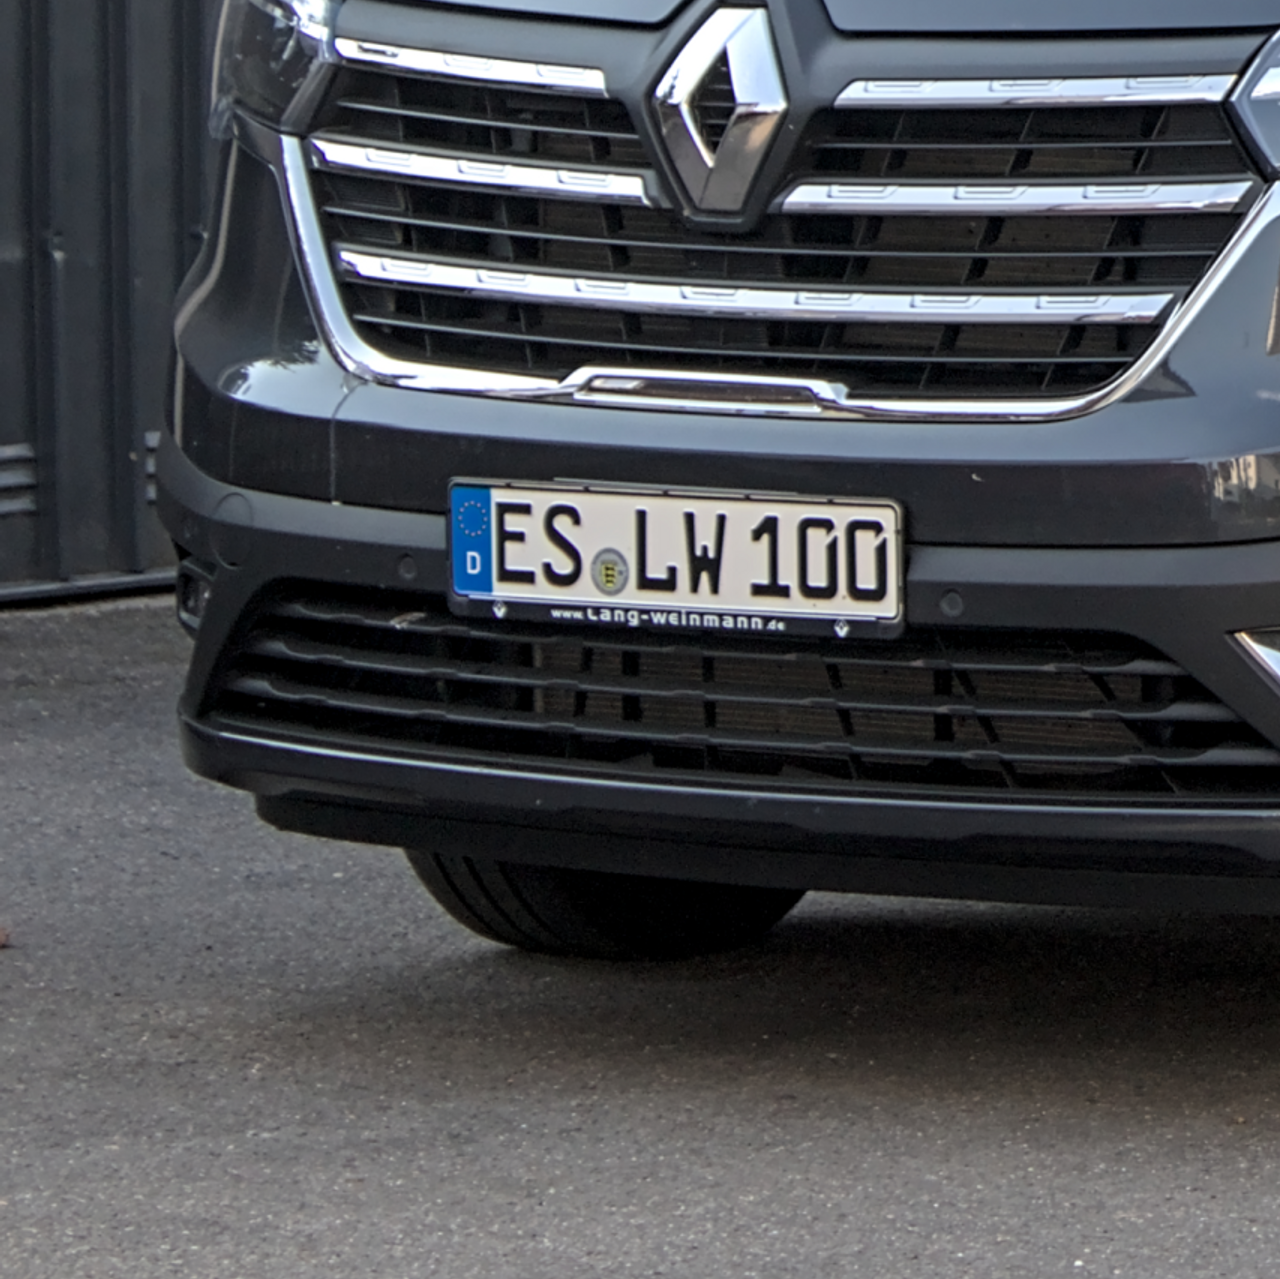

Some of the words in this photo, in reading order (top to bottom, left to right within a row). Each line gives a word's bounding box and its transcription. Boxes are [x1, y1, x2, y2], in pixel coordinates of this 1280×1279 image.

[466, 551, 481, 574] D
[496, 501, 583, 587] ES
[635, 508, 727, 595] LW
[750, 515, 888, 602] 100
